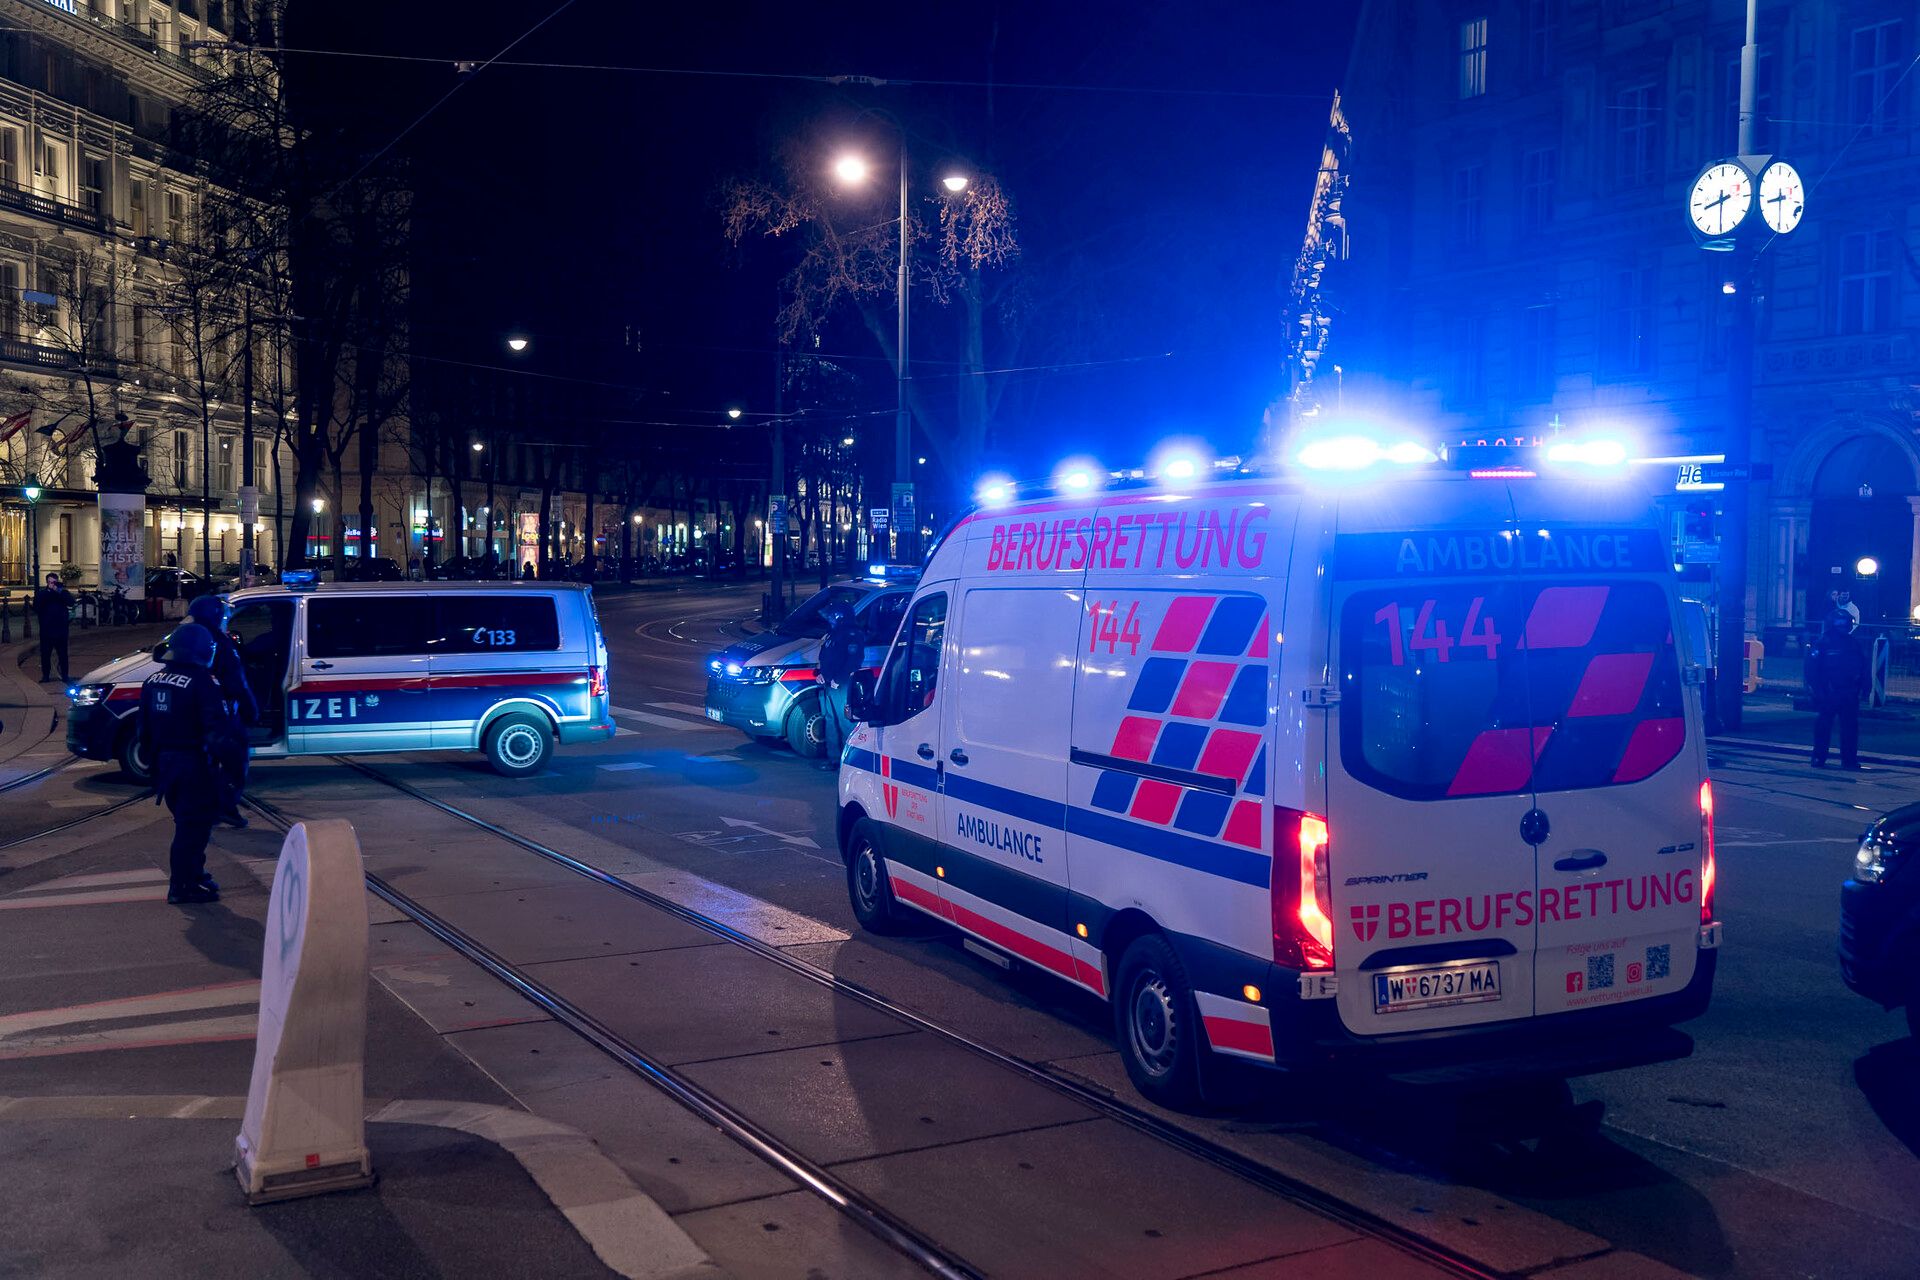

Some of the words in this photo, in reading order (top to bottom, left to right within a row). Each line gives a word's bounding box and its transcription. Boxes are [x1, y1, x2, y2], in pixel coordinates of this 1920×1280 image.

[987, 506, 1271, 571] BERUFSRETTUNG
[1396, 534, 1633, 573] AMBULANCE
[487, 629, 516, 646] 133
[1089, 600, 1142, 656] 144
[1374, 596, 1502, 666] 144
[147, 672, 193, 689] POLIZEI
[157, 691, 166, 703] U
[292, 697, 357, 719] IZEI
[958, 812, 1043, 864] AMBULANCE
[1344, 872, 1428, 886] SPRINTER
[1388, 870, 1694, 939] BERUFSRETTUNG
[1390, 978, 1404, 1000] W
[1420, 971, 1464, 997] 6737
[1470, 968, 1496, 993] MA
